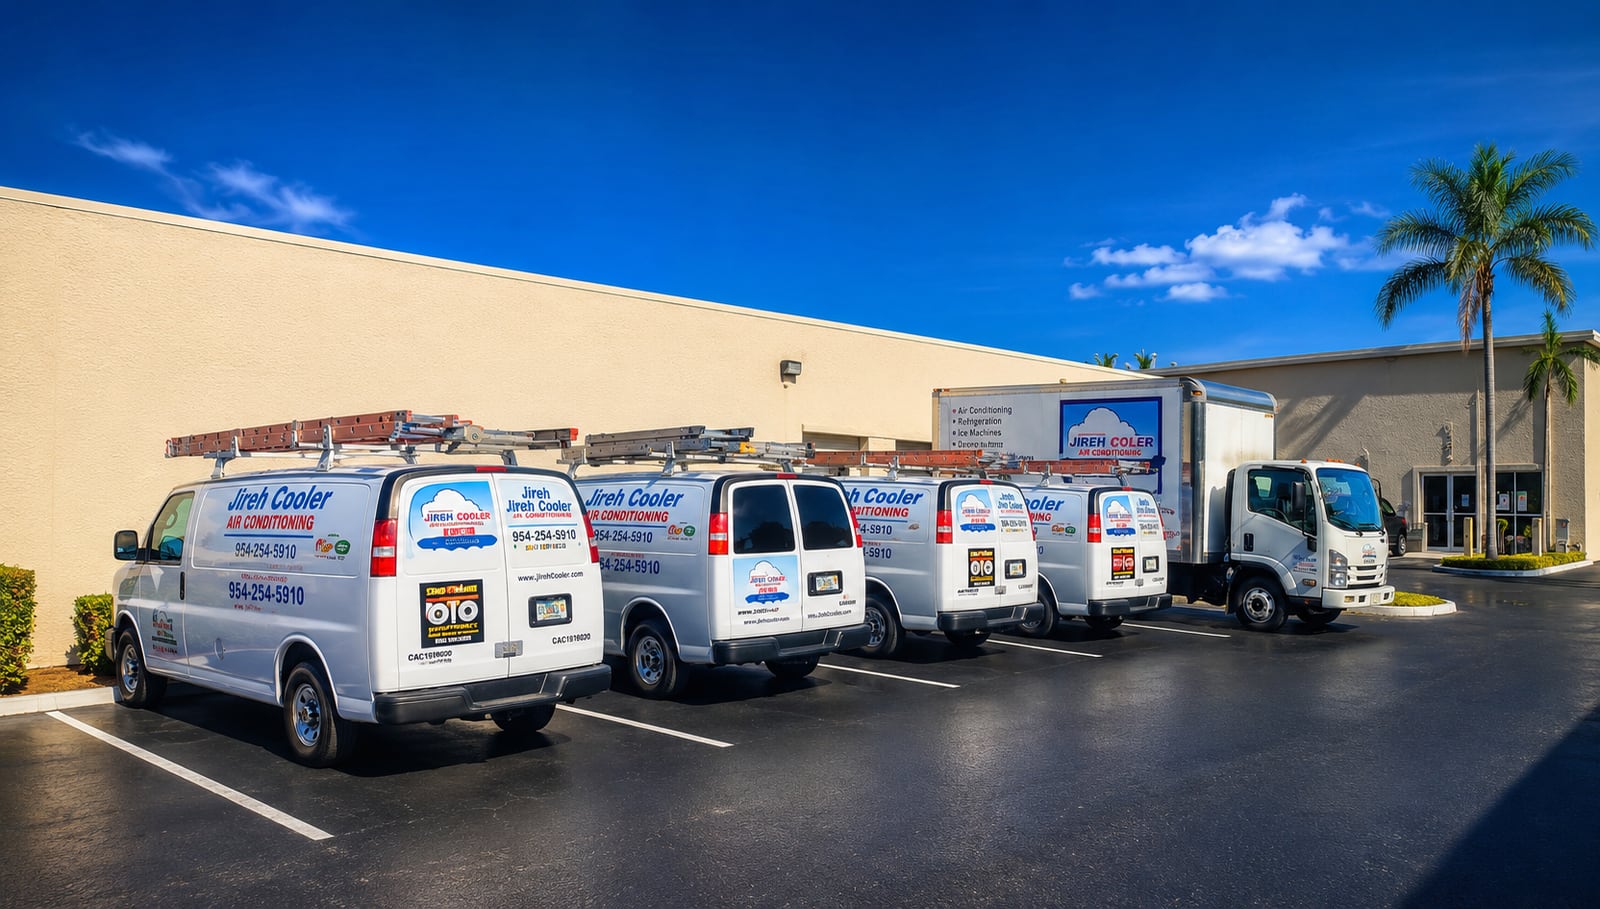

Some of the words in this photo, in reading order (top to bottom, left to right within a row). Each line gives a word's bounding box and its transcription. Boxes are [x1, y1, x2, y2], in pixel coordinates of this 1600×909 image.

[958, 406, 968, 414] Air
[969, 406, 1013, 416] Conditioning
[957, 417, 1002, 427] Refrigeration
[957, 429, 969, 437] Ice
[970, 428, 1002, 437] Machines
[1069, 437, 1106, 447] JIREH
[1110, 436, 1154, 447] COLER
[227, 486, 269, 511] Jireh
[271, 485, 333, 511] Cooler
[522, 486, 551, 500] Jireh
[586, 488, 625, 507] Jireh
[628, 488, 684, 507] Cooler
[864, 488, 924, 505] Cooler
[506, 500, 535, 513] Jireh
[538, 500, 572, 512] Cooler
[226, 515, 242, 529] AIR
[243, 515, 315, 530] CONDITIONING
[456, 511, 491, 521] COOLER
[601, 510, 669, 522] CONDITIONING
[235, 542, 297, 560] 954-254-5910
[229, 581, 305, 606] 954-254-5910
